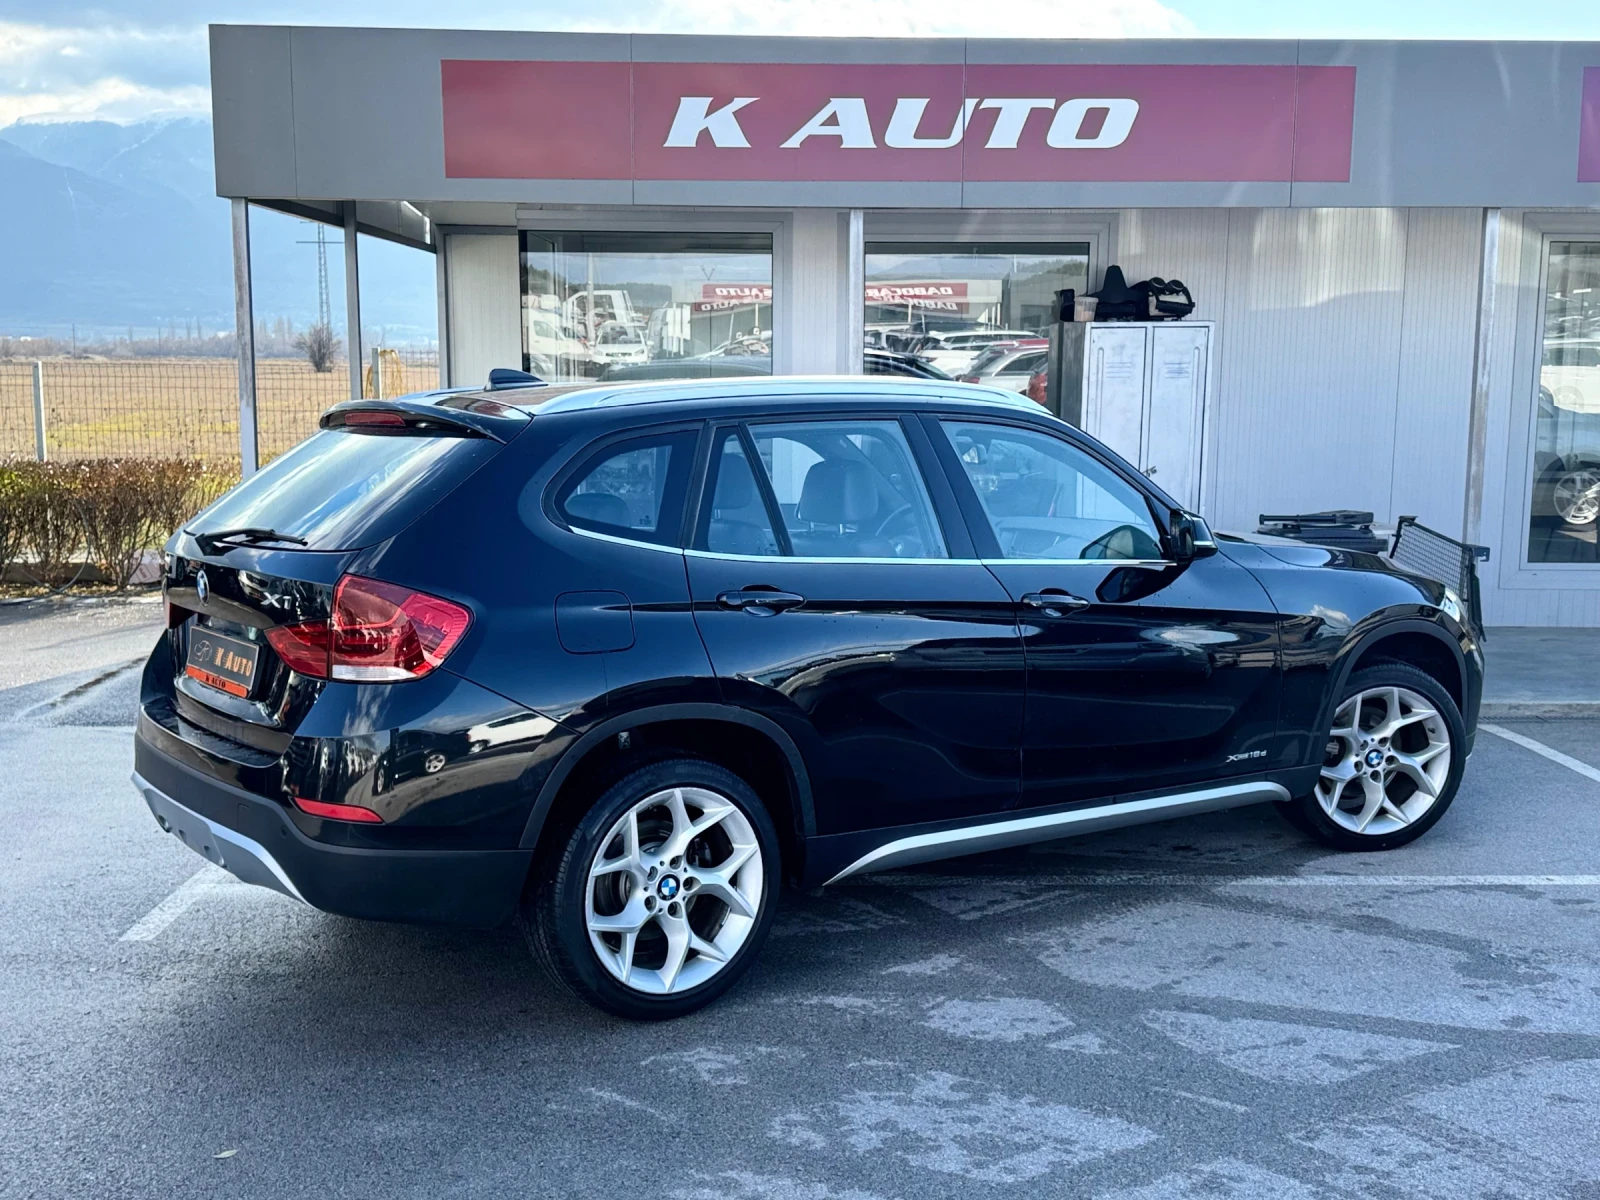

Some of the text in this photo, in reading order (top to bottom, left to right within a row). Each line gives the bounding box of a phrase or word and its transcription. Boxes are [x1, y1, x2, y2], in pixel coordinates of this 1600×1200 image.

[663, 96, 1139, 149] K AUTO
[260, 591, 292, 610] X1
